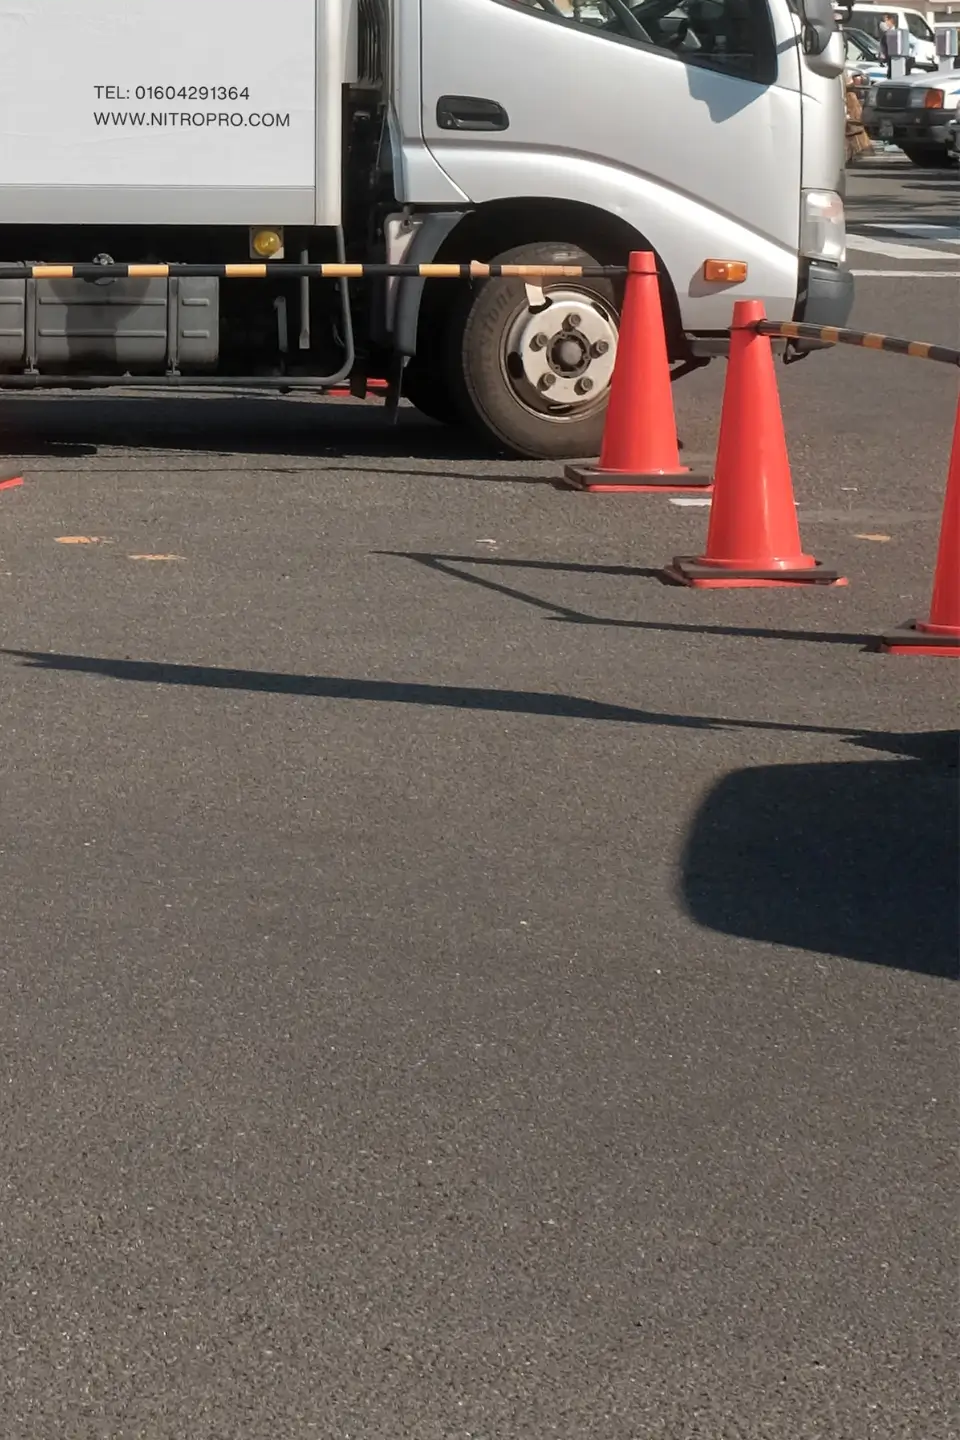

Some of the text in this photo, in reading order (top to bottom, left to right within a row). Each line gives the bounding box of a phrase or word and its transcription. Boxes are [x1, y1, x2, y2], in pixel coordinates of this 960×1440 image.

[93, 85, 250, 101] TEL: 01604291364
[93, 111, 290, 127] WWW.NITROPRO.COM
